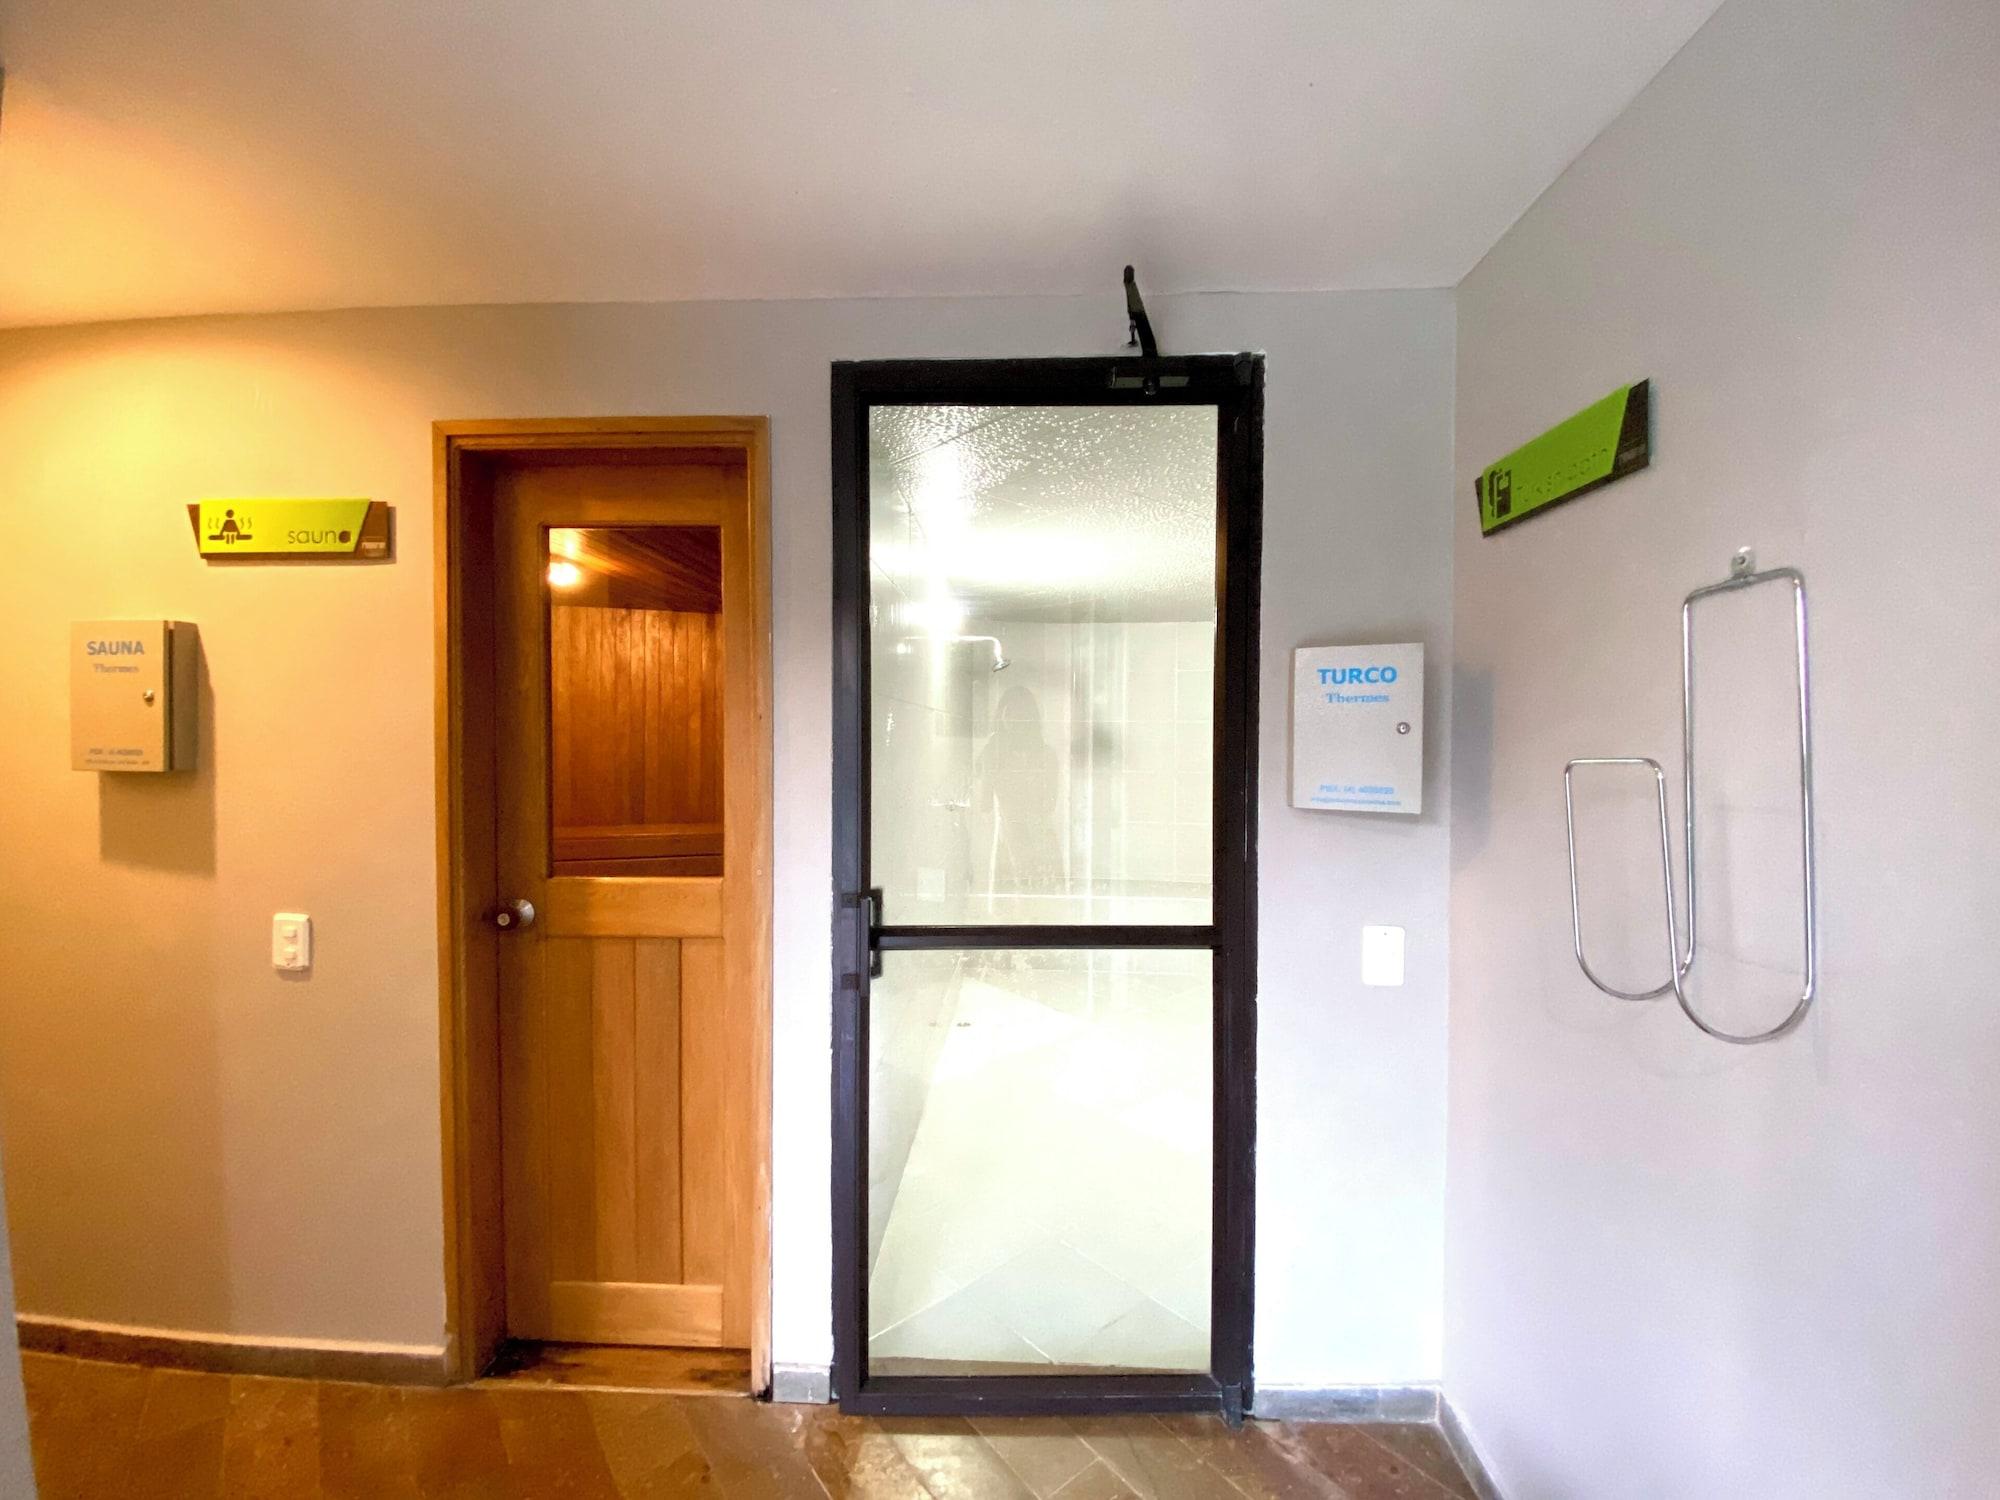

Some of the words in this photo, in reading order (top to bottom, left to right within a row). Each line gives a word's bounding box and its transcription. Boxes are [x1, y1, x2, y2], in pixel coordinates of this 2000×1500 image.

[288, 530, 351, 544] sauna
[87, 641, 144, 655] SAUNA
[1317, 666, 1397, 684] TURCO
[1326, 693, 1390, 704] Thermes
